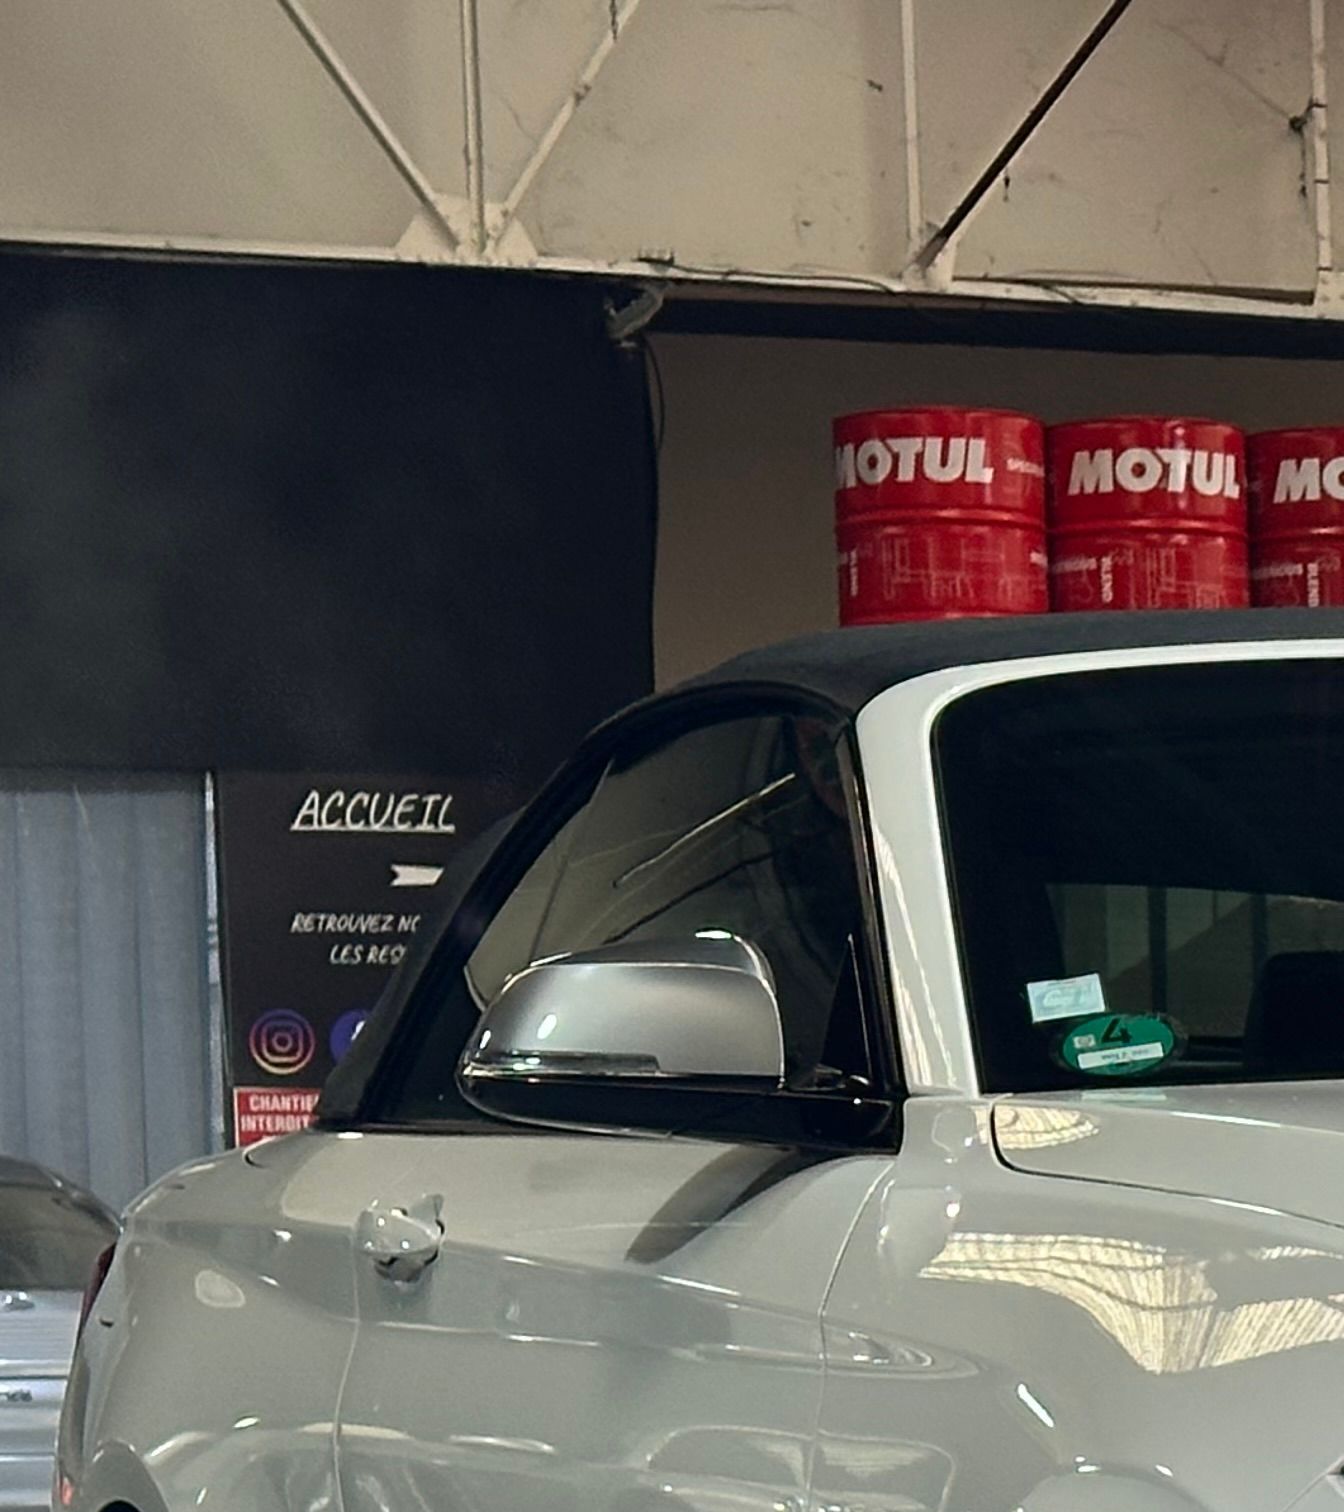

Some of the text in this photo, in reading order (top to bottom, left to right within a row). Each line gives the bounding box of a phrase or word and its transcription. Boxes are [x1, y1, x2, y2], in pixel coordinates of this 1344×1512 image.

[1067, 448, 1240, 499] MOTUL
[291, 790, 455, 832] ACCUEIL
[290, 911, 394, 934] RETROUVEZ
[329, 944, 361, 965] LES
[1101, 1017, 1132, 1044] 4
[249, 1093, 320, 1112] CHANTIE
[240, 1114, 310, 1131] INTERDIT
